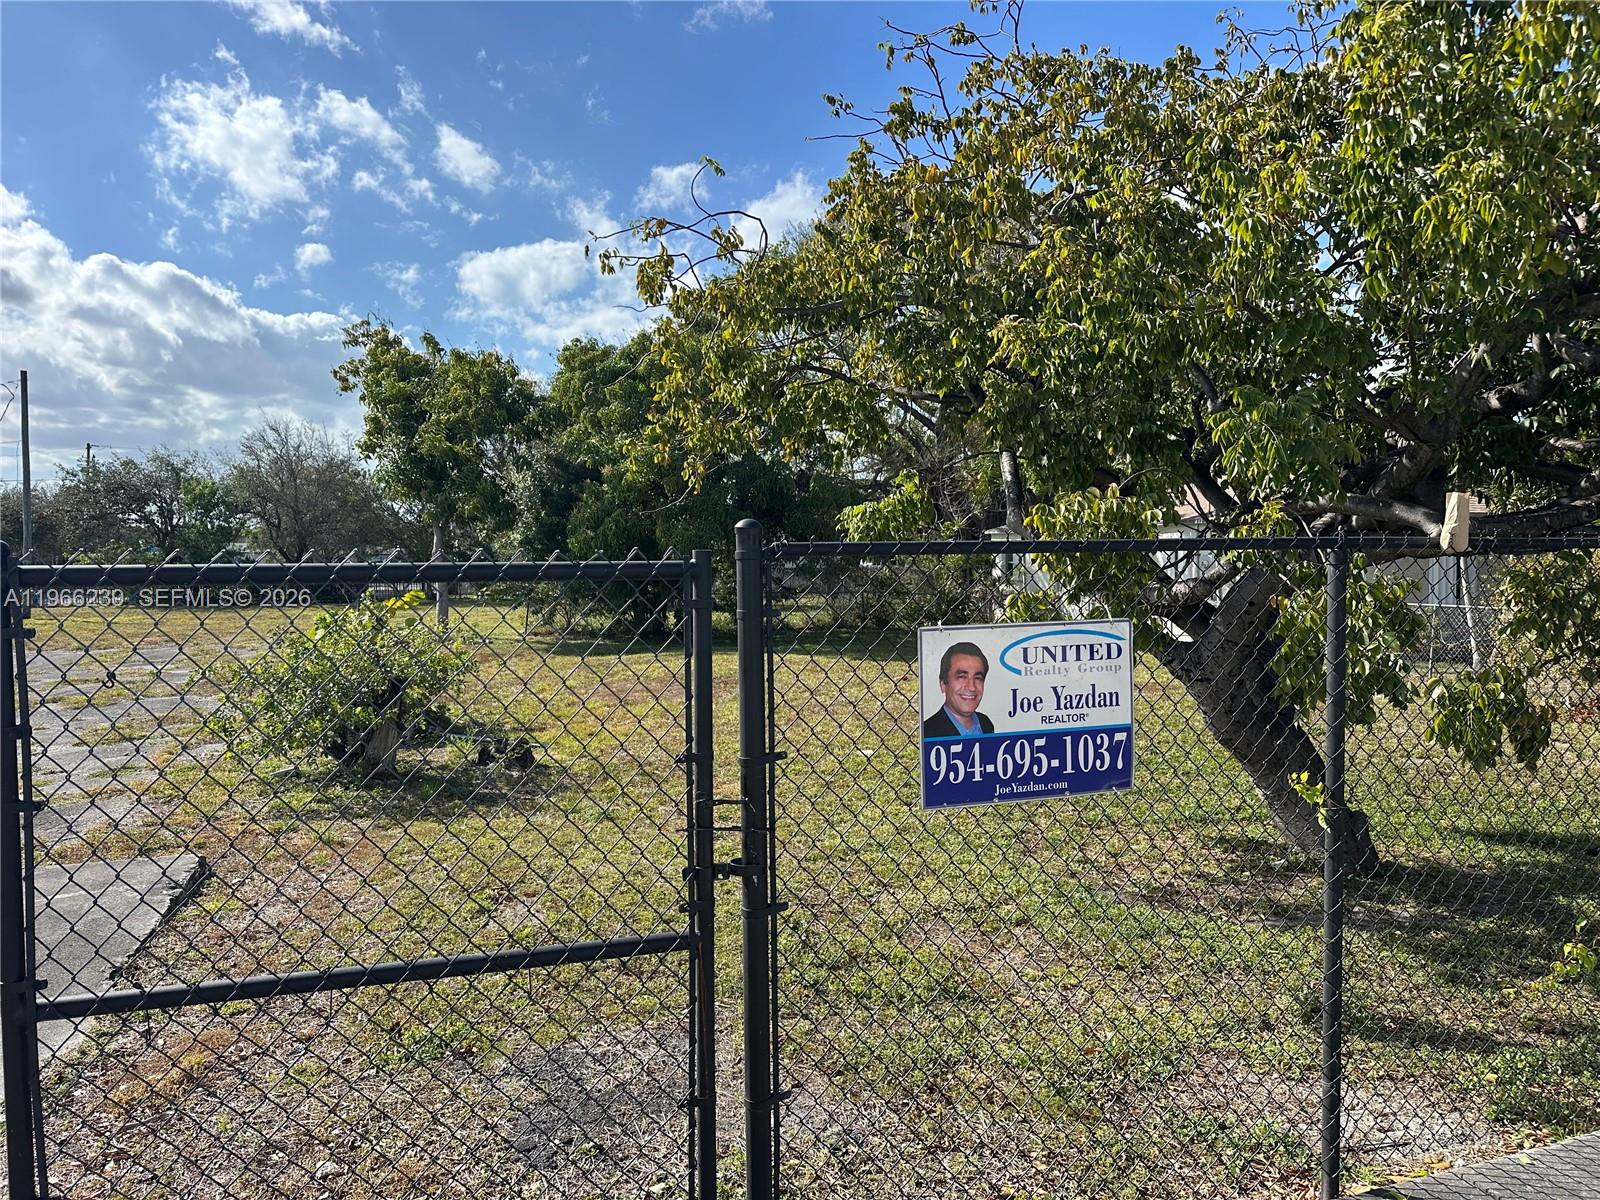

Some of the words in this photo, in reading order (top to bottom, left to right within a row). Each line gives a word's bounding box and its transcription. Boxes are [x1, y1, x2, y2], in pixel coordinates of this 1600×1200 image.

[1021, 643, 1123, 664] UNITED
[1024, 665, 1070, 677] Realty
[1078, 663, 1122, 674] Group
[1008, 688, 1044, 718] Joe
[1051, 684, 1120, 711] Yazdan
[929, 732, 1128, 786] 954-695-1037
[994, 781, 1068, 796] JoeYazdan.com
